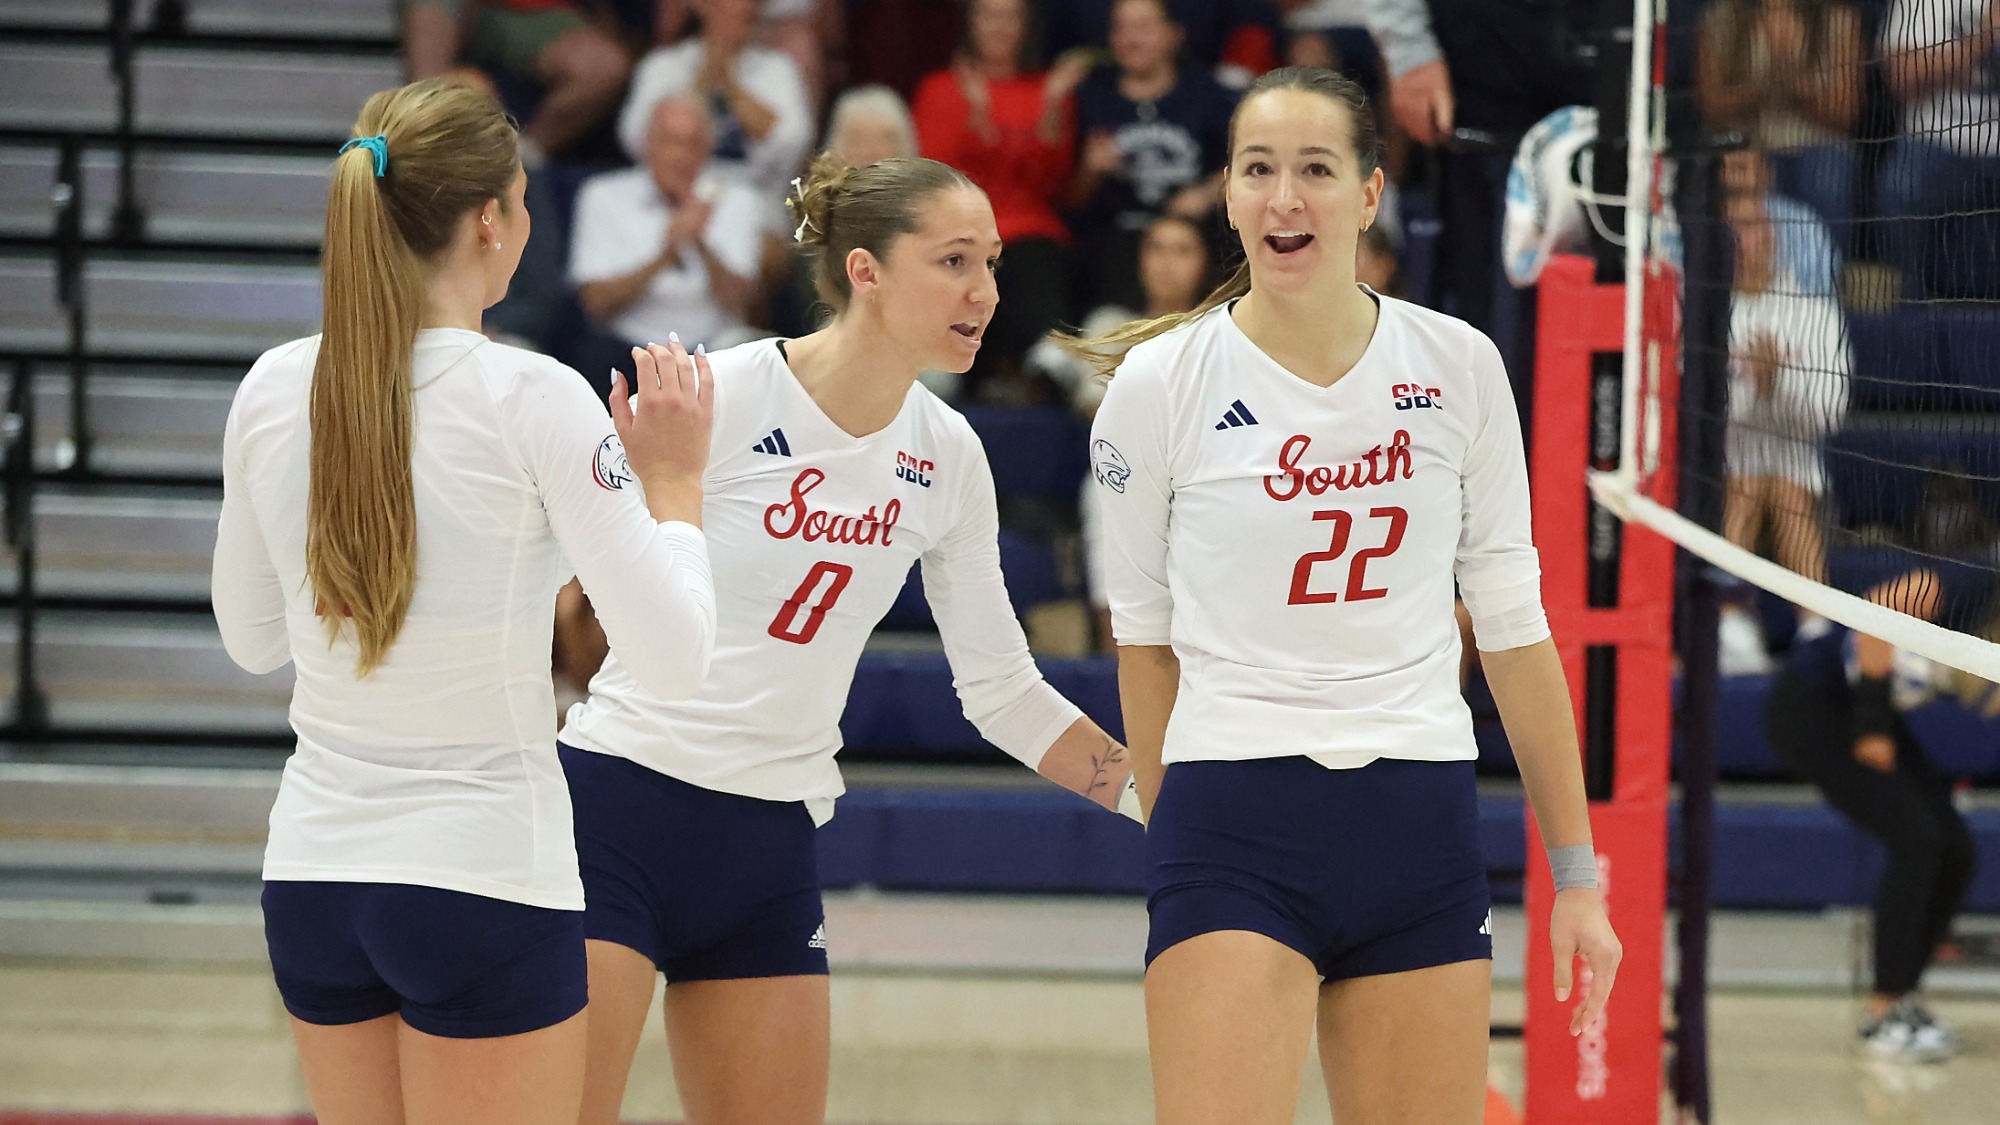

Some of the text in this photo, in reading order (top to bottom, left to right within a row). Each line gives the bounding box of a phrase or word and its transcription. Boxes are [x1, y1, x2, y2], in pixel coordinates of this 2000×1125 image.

[1392, 383, 1443, 411] SBC
[896, 450, 934, 488] SBC
[1263, 429, 1414, 501] South
[1287, 506, 1409, 605] 22
[767, 560, 853, 645] 0
